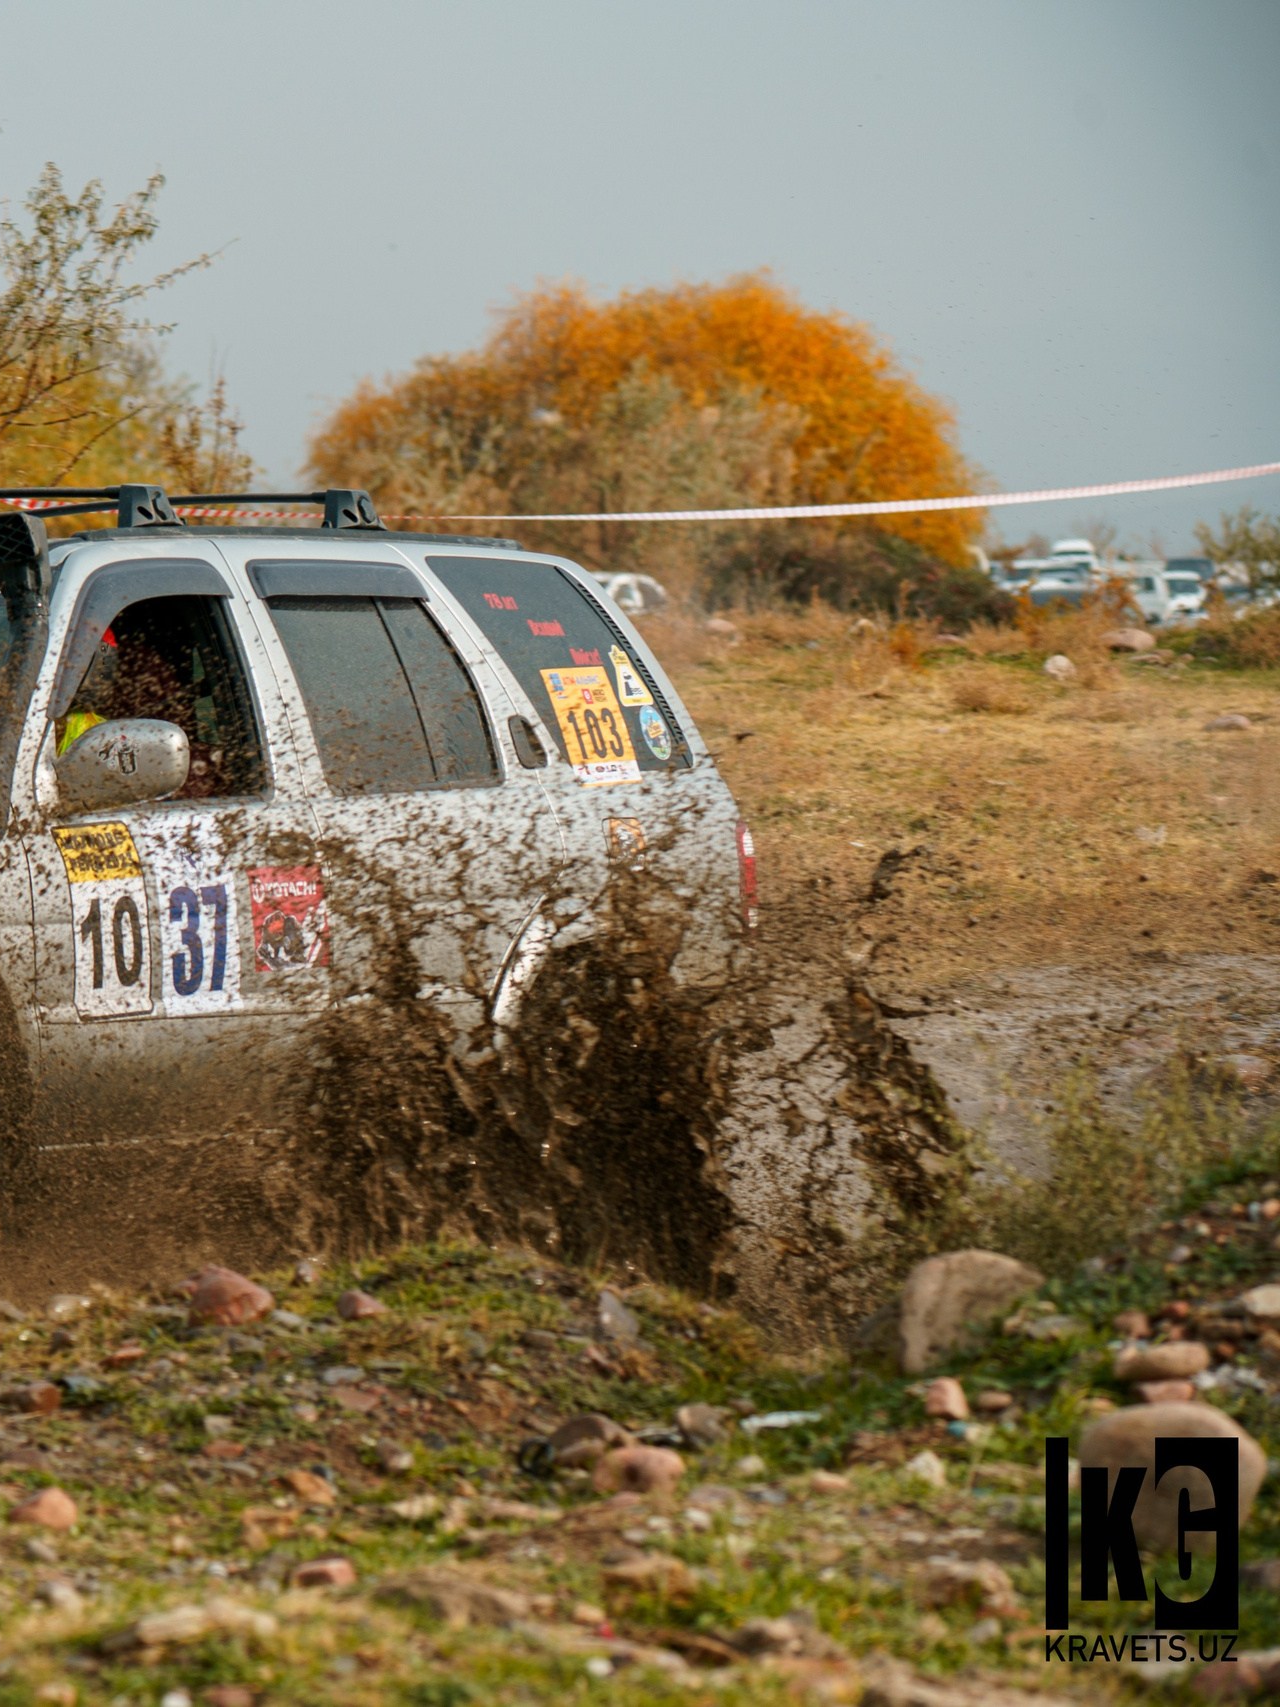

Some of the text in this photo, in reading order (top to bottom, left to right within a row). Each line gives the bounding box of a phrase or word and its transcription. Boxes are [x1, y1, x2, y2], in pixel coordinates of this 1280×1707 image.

[483, 593, 501, 610] 78
[568, 708, 624, 760] 103
[81, 896, 143, 989] 10
[169, 885, 227, 996] 37
